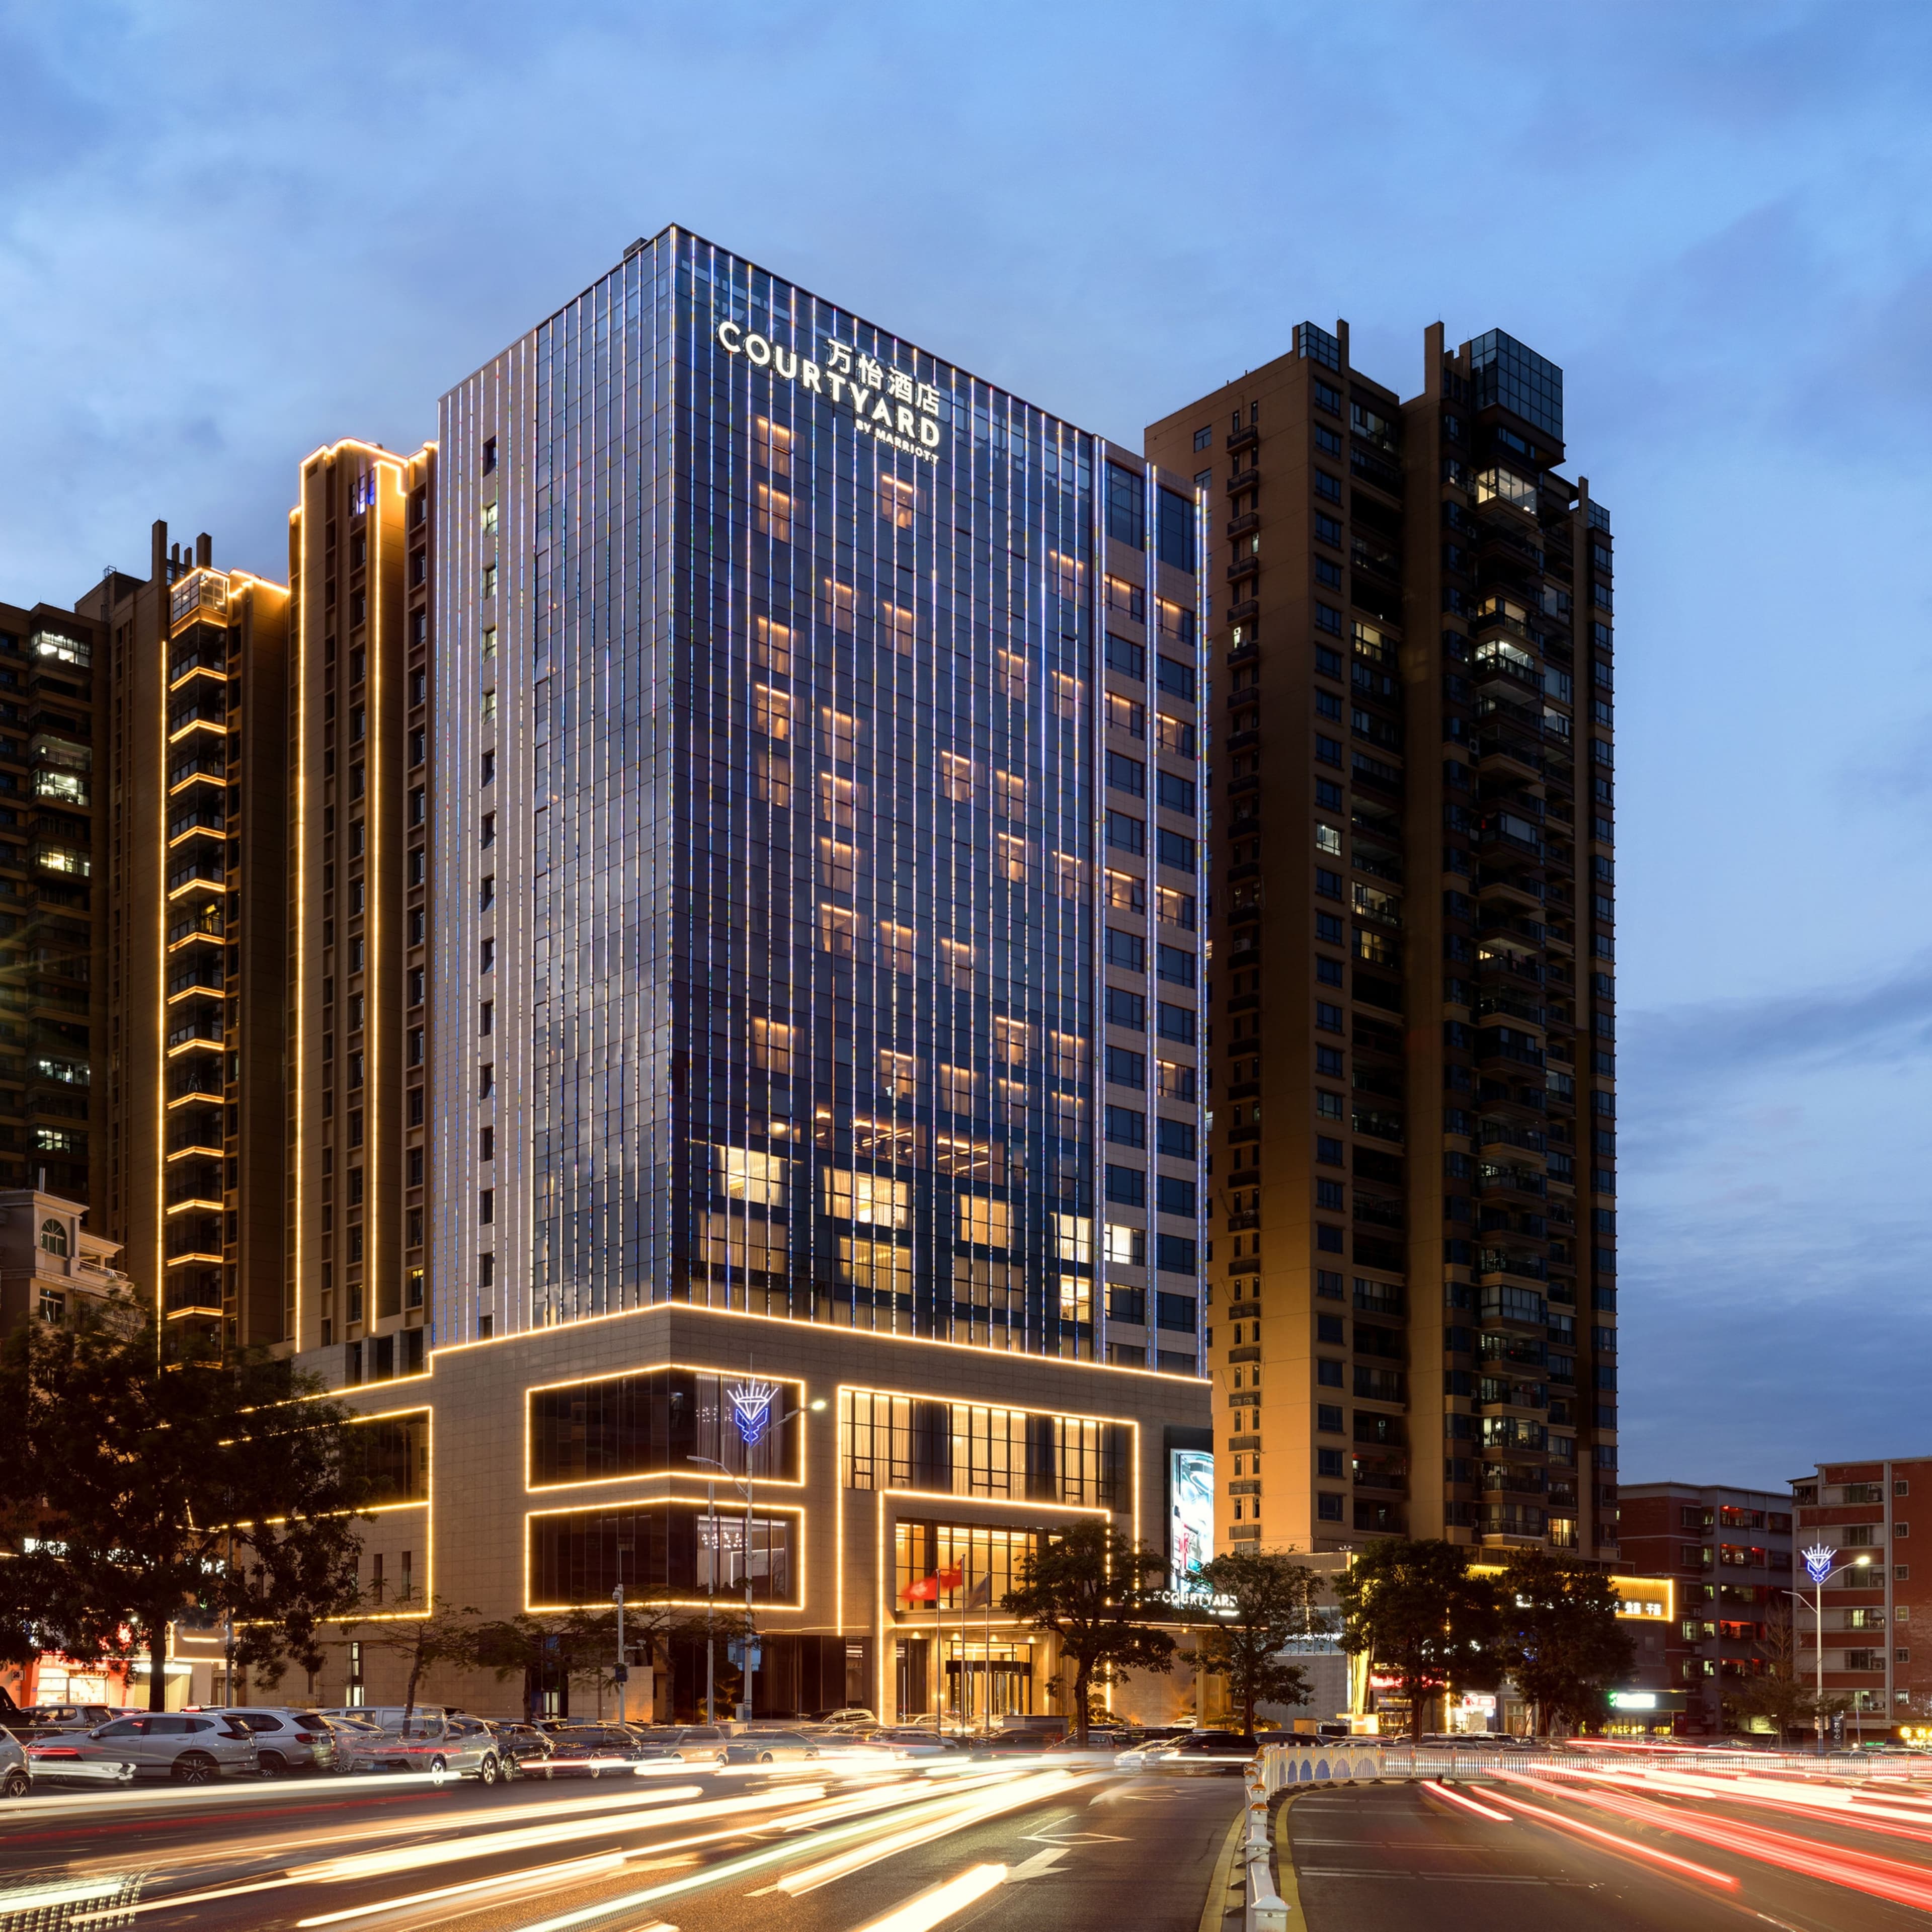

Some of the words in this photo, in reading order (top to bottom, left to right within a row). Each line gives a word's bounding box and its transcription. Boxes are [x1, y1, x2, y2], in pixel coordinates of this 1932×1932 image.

[718, 321, 940, 447] COURTYARD
[828, 338, 940, 416] 万怡酒店
[856, 420, 871, 434] BY
[876, 427, 939, 465] MARRIOTT
